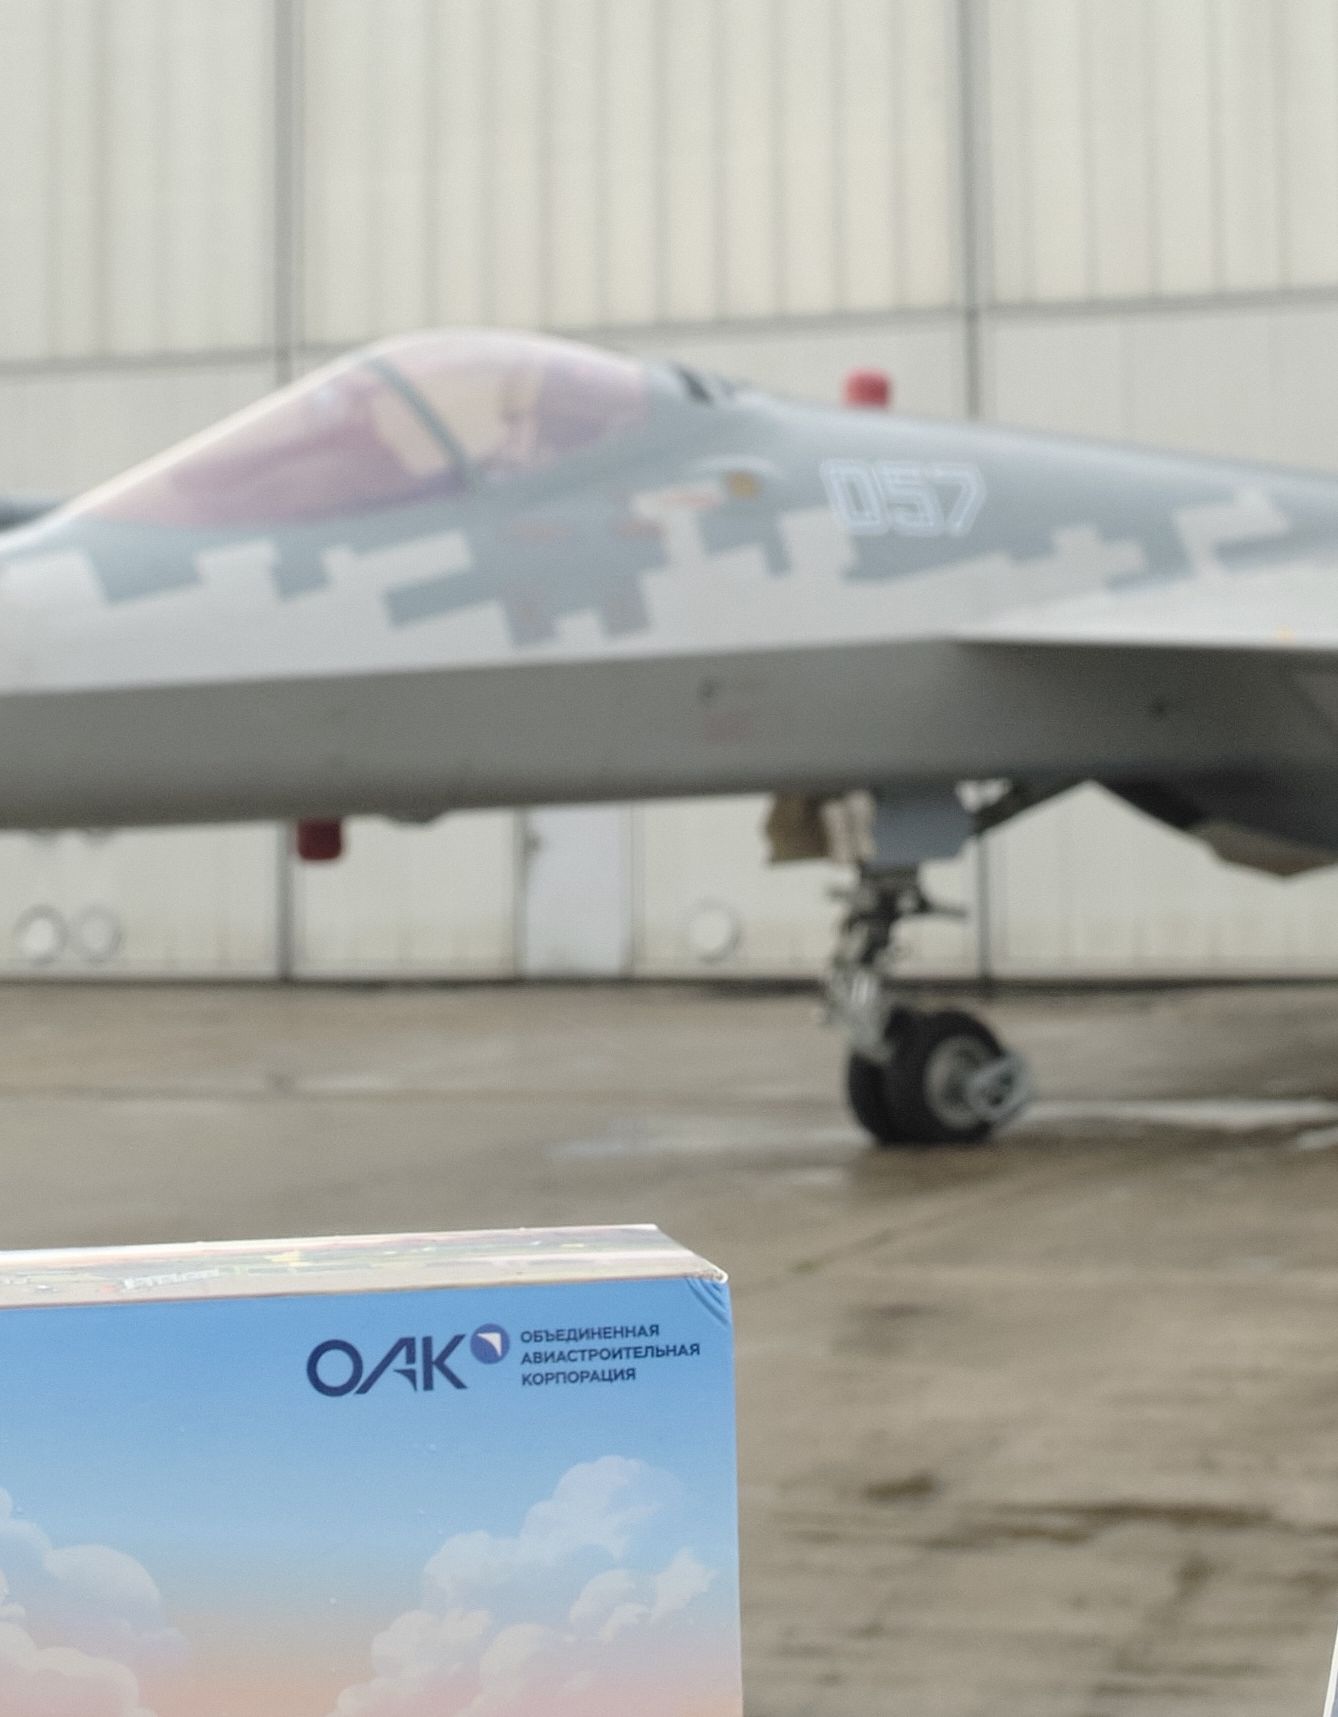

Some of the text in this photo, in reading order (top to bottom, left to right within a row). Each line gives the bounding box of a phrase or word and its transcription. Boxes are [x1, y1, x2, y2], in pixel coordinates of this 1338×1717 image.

[819, 458, 988, 538] 057
[520, 1324, 660, 1344] ОБЪЕДИНЕННАЯ
[306, 1333, 469, 1397] ОАК
[520, 1342, 701, 1366] АВИАСТРОИТЕЛЬНАЯ
[520, 1367, 637, 1387] КОРПОРАЦИЯ
